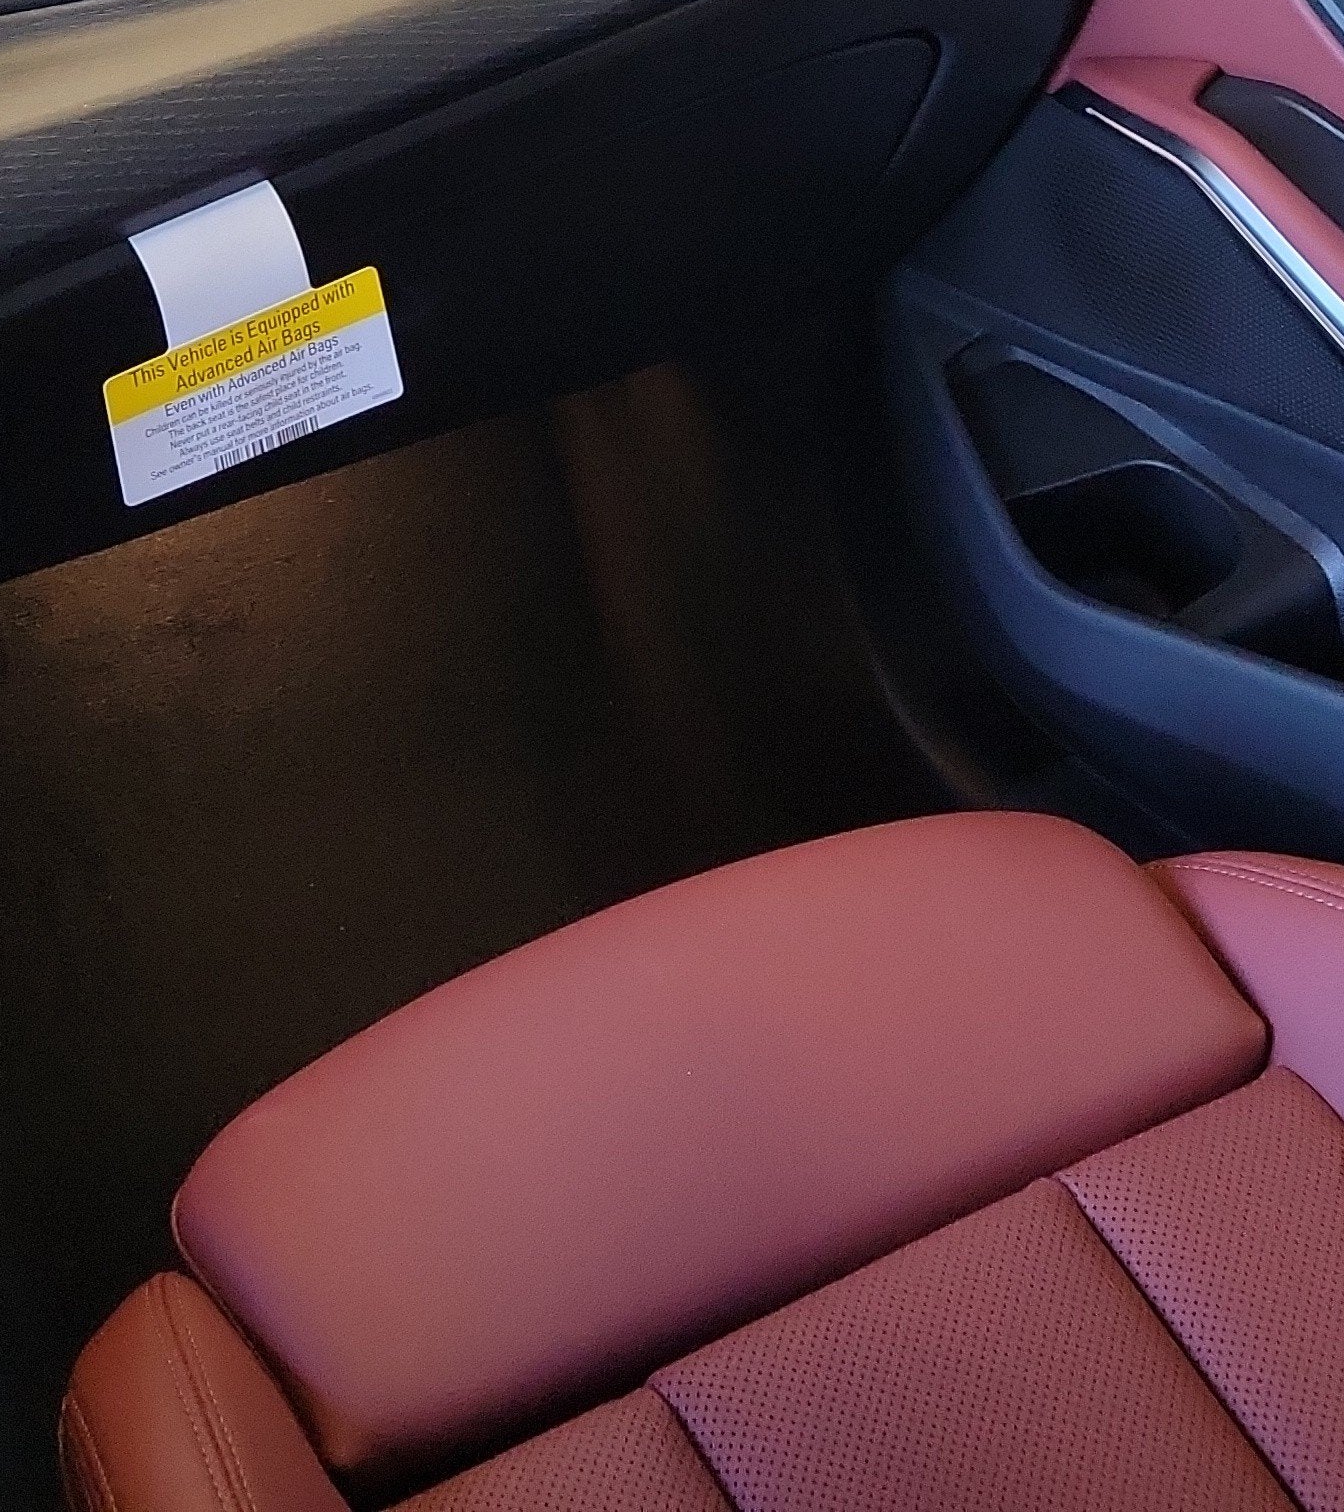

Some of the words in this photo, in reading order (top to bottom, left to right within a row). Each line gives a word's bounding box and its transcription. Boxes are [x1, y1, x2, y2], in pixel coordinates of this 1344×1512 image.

[129, 362, 165, 388] This
[167, 337, 226, 371] Vehicle
[230, 330, 244, 347] is
[247, 294, 320, 339] Equipped
[322, 280, 355, 306] with
[176, 347, 254, 393] Advanced
[257, 336, 279, 360] Air
[282, 319, 321, 346] Bags
[164, 397, 196, 417] Even
[198, 384, 225, 403] with
[228, 354, 287, 393] Advanced
[289, 349, 306, 365] Air
[307, 335, 339, 356] Bags
[146, 418, 181, 438] Children
[169, 434, 196, 451] Never
